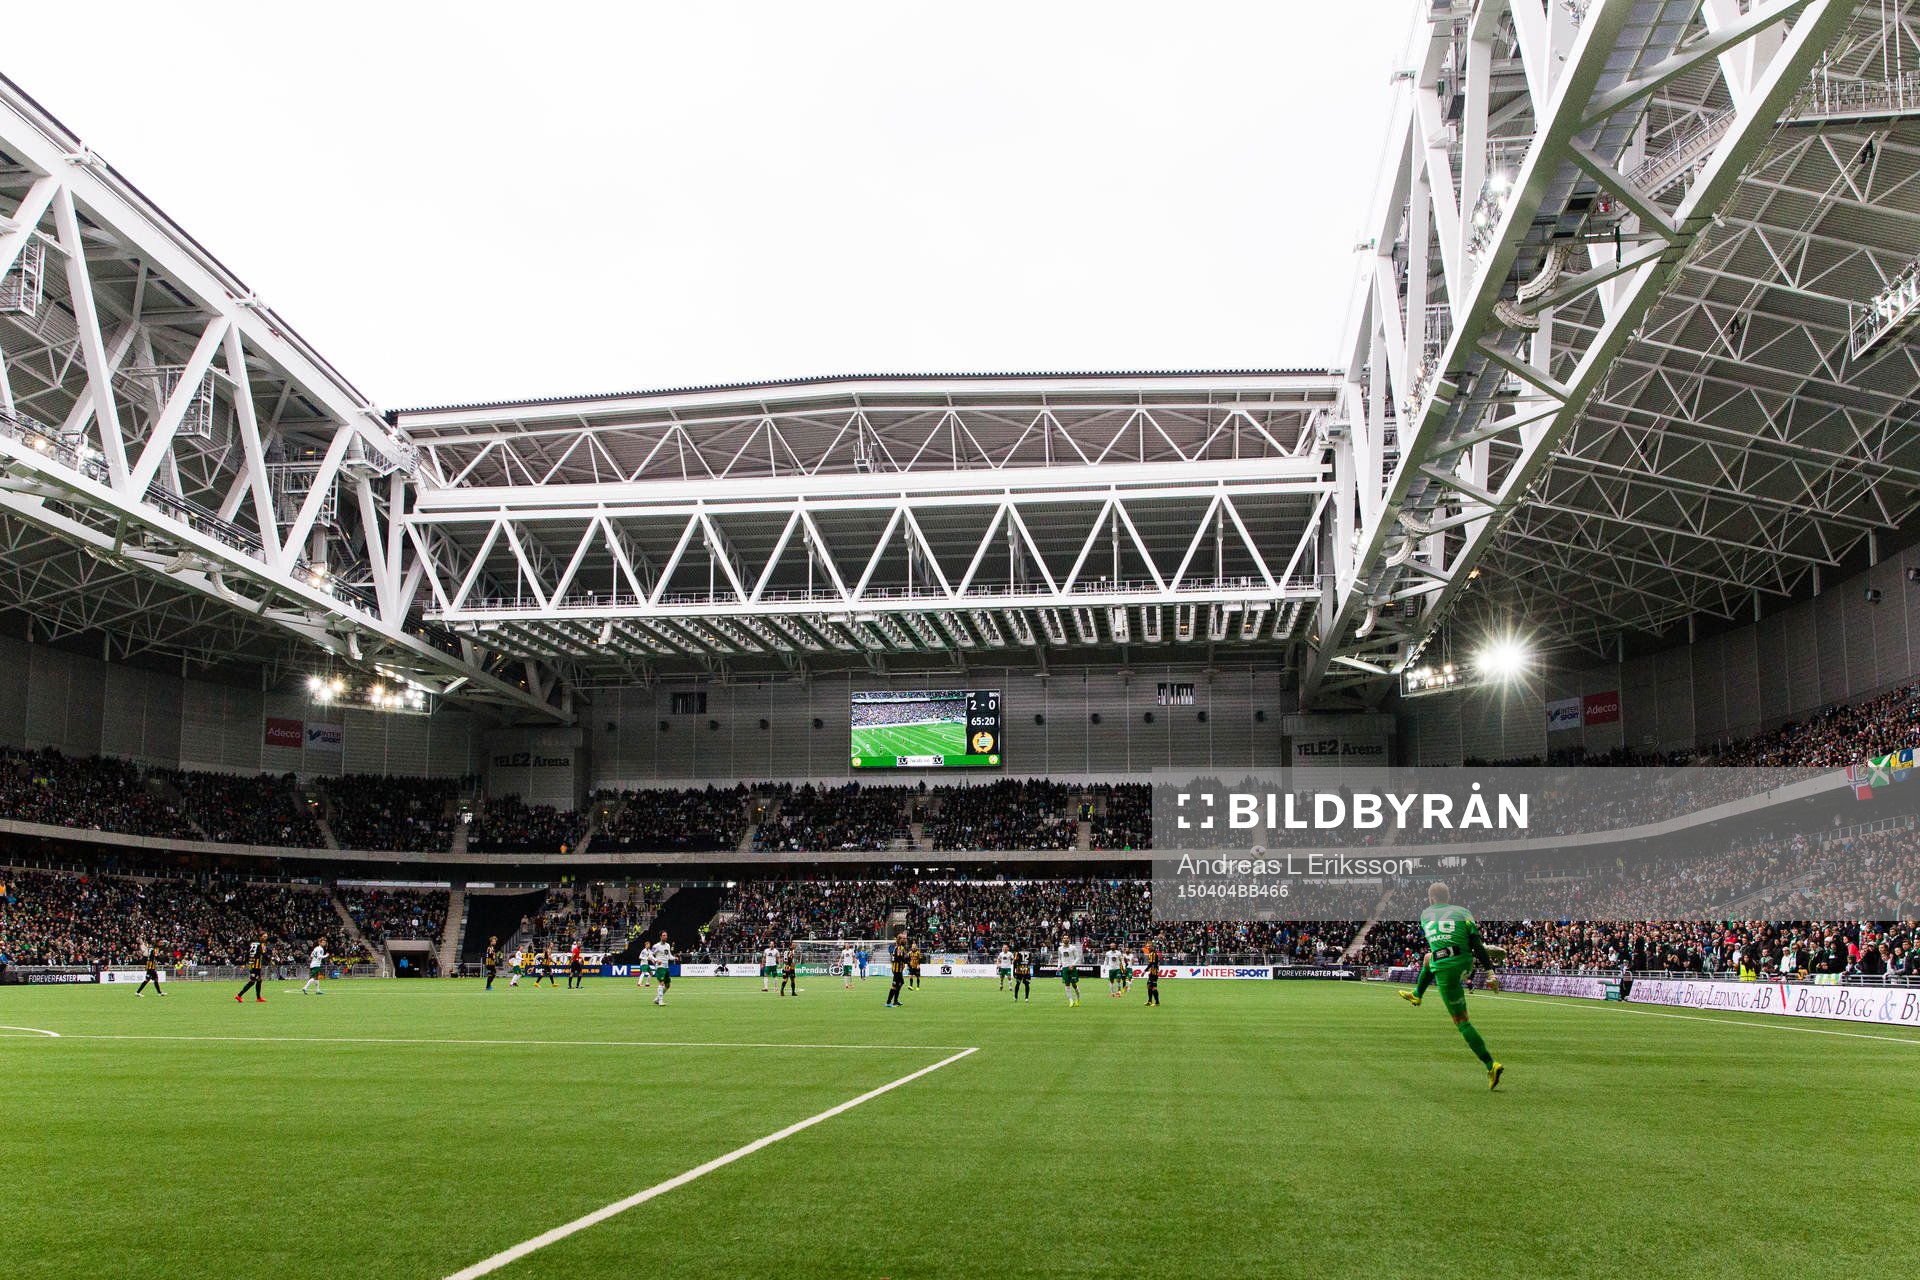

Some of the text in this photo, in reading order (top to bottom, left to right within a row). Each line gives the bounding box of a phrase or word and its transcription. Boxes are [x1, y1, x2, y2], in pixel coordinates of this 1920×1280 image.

[970, 700, 977, 710] 2
[989, 700, 996, 710] 0
[1586, 703, 1618, 715] Adecco
[971, 717, 995, 726] 65:20
[267, 727, 301, 739] Adecco
[1296, 739, 1383, 756] TELE2 Arena
[494, 752, 570, 767] TELE2 Arena
[1425, 909, 1456, 937] 26
[1202, 968, 1270, 978] INTERSPORT
[1750, 987, 1773, 1009] AB
[1796, 988, 1835, 1014] BODIN
[1835, 990, 1875, 1017] BYGG
[1878, 990, 1897, 1021] &
